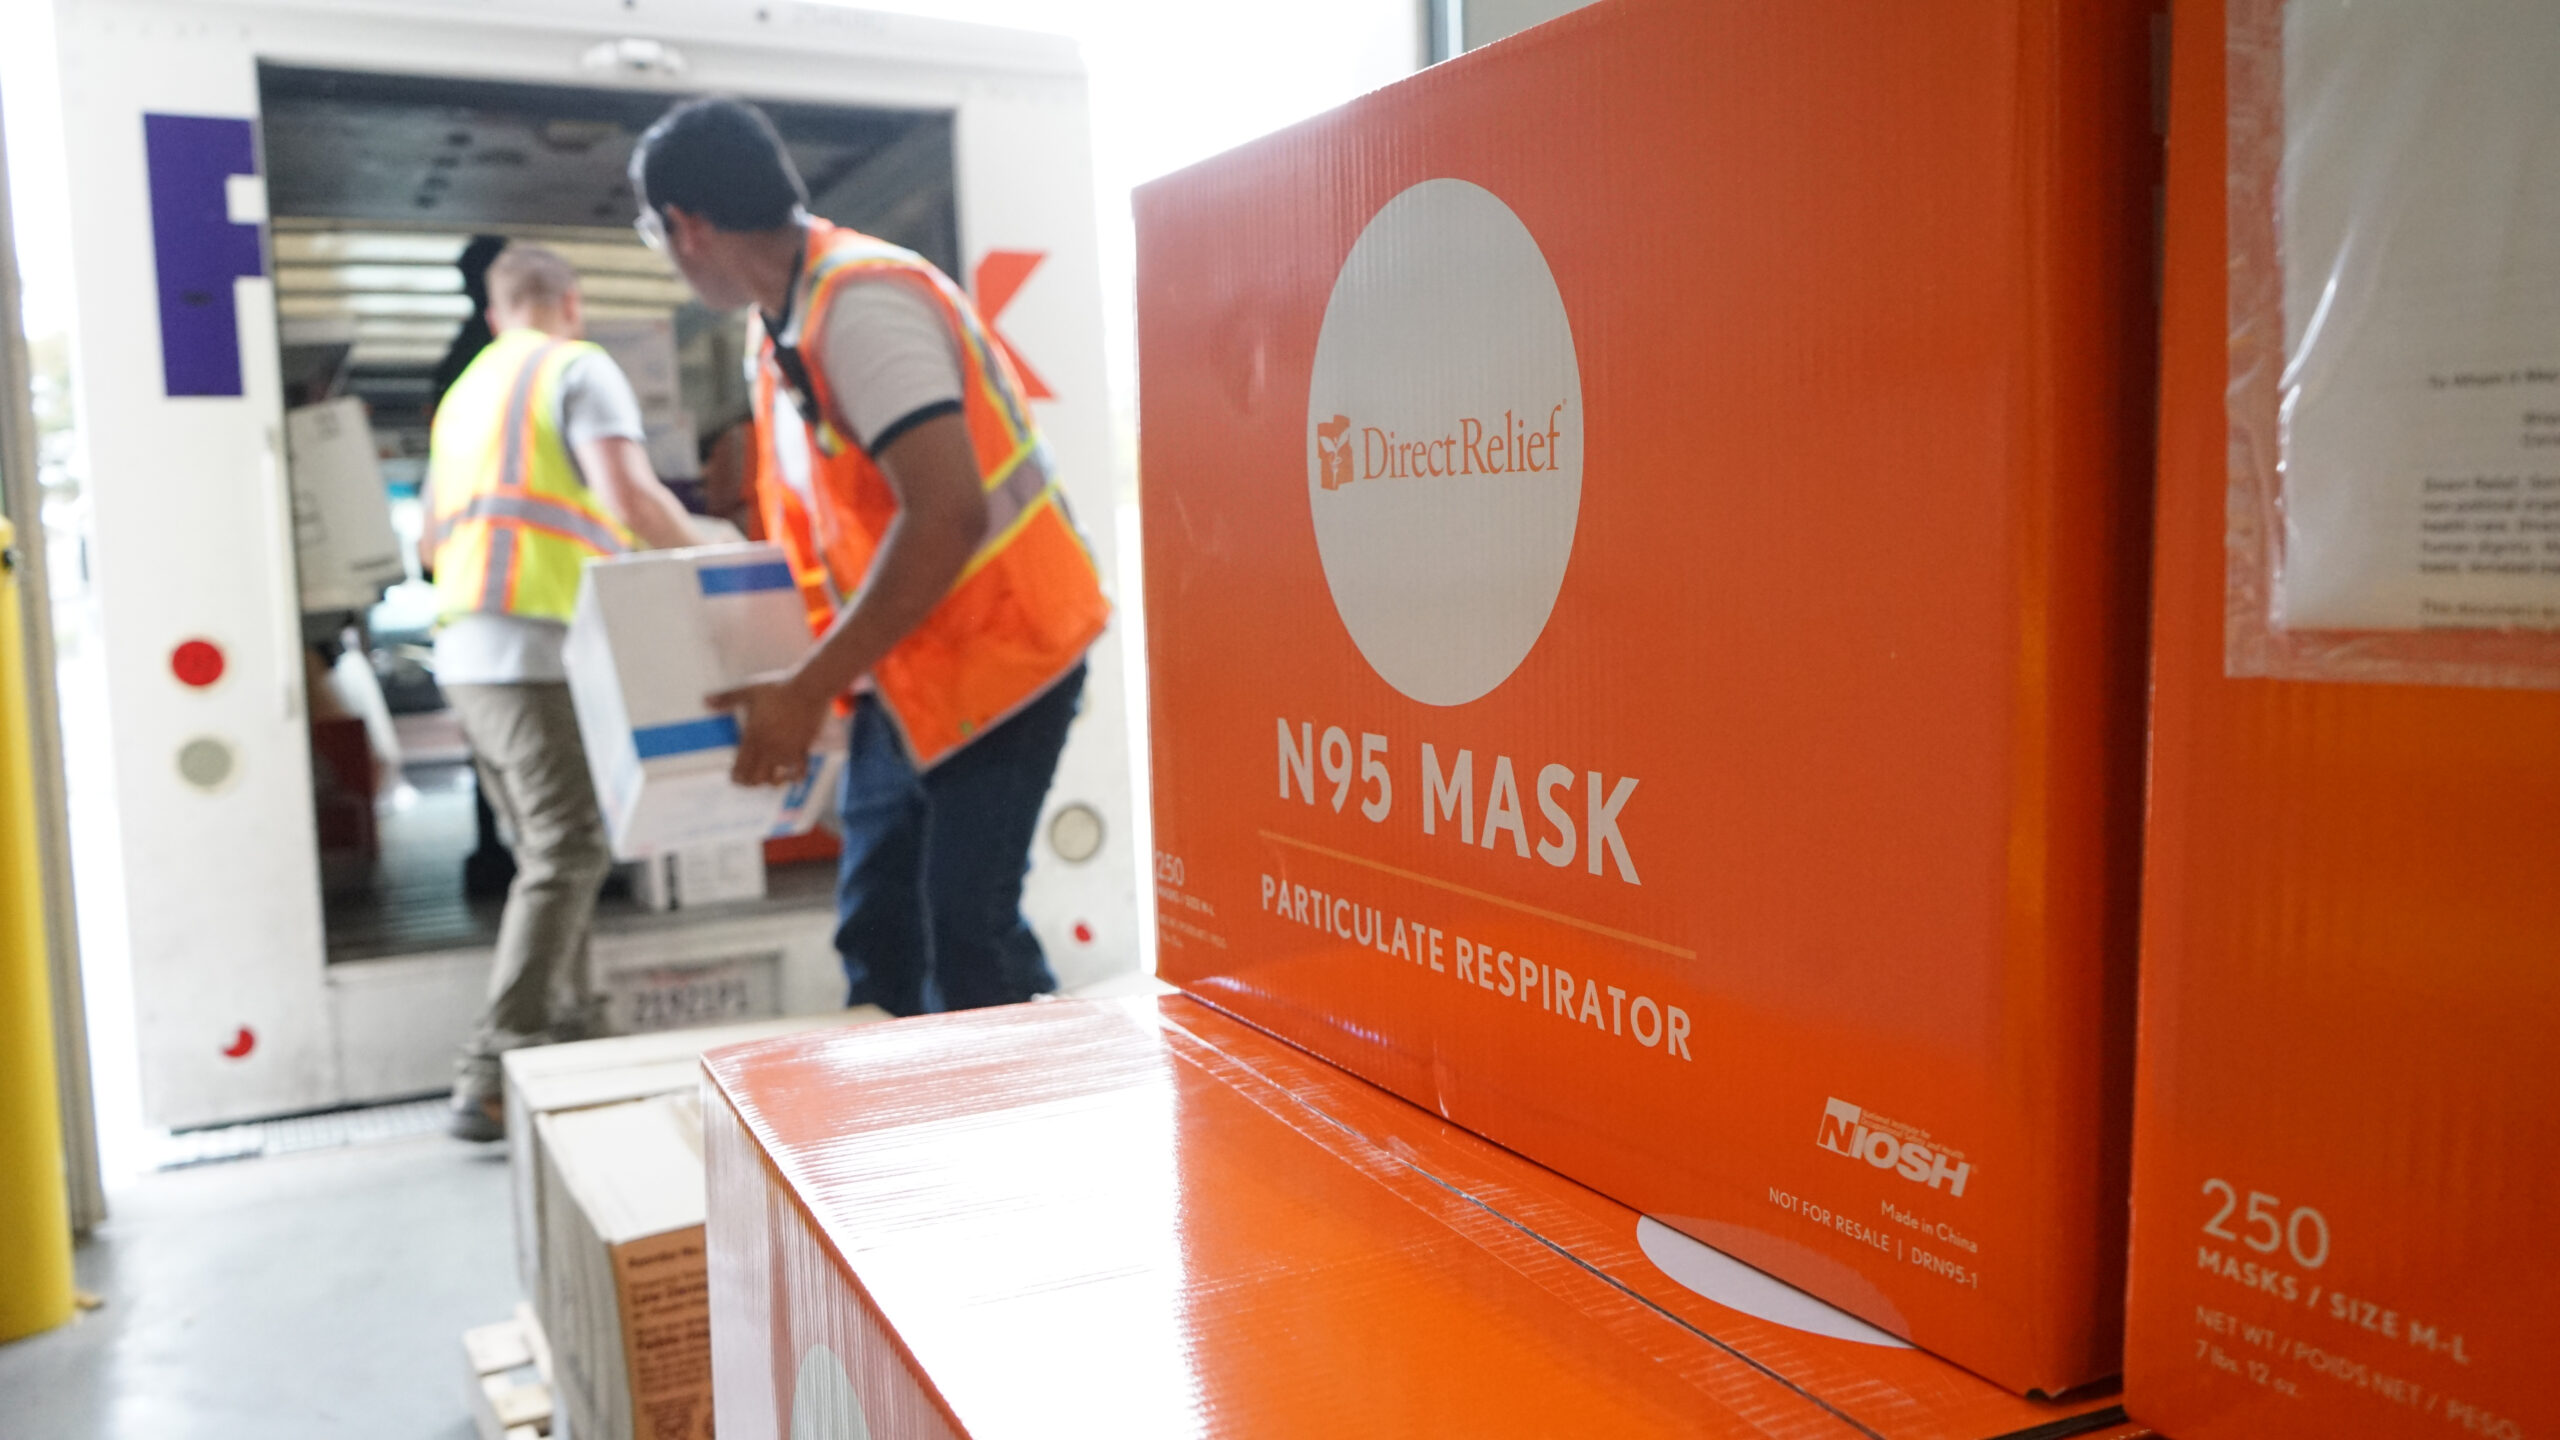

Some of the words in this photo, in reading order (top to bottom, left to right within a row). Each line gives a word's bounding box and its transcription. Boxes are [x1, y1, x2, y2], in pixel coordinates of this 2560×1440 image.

[1277, 717, 1392, 823] N95
[1421, 742, 1642, 885] MASK
[1261, 873, 1445, 973] PARTICULATE
[1456, 936, 1692, 1061] RESPIRATOR
[1816, 1096, 1971, 1198] NIOSH
[1769, 1186, 1799, 1213] NOT
[1802, 1200, 1831, 1227] FOR
[1835, 1215, 1890, 1251] RESALE
[1911, 1247, 1978, 1290] DRN95-1
[1881, 1200, 1919, 1229] Made
[1921, 1217, 1934, 1234] in
[1936, 1223, 1978, 1253] China
[2202, 1178, 2330, 1269] 250
[2198, 1246, 2299, 1301] MASKS
[2329, 1291, 2399, 1339] SIZE
